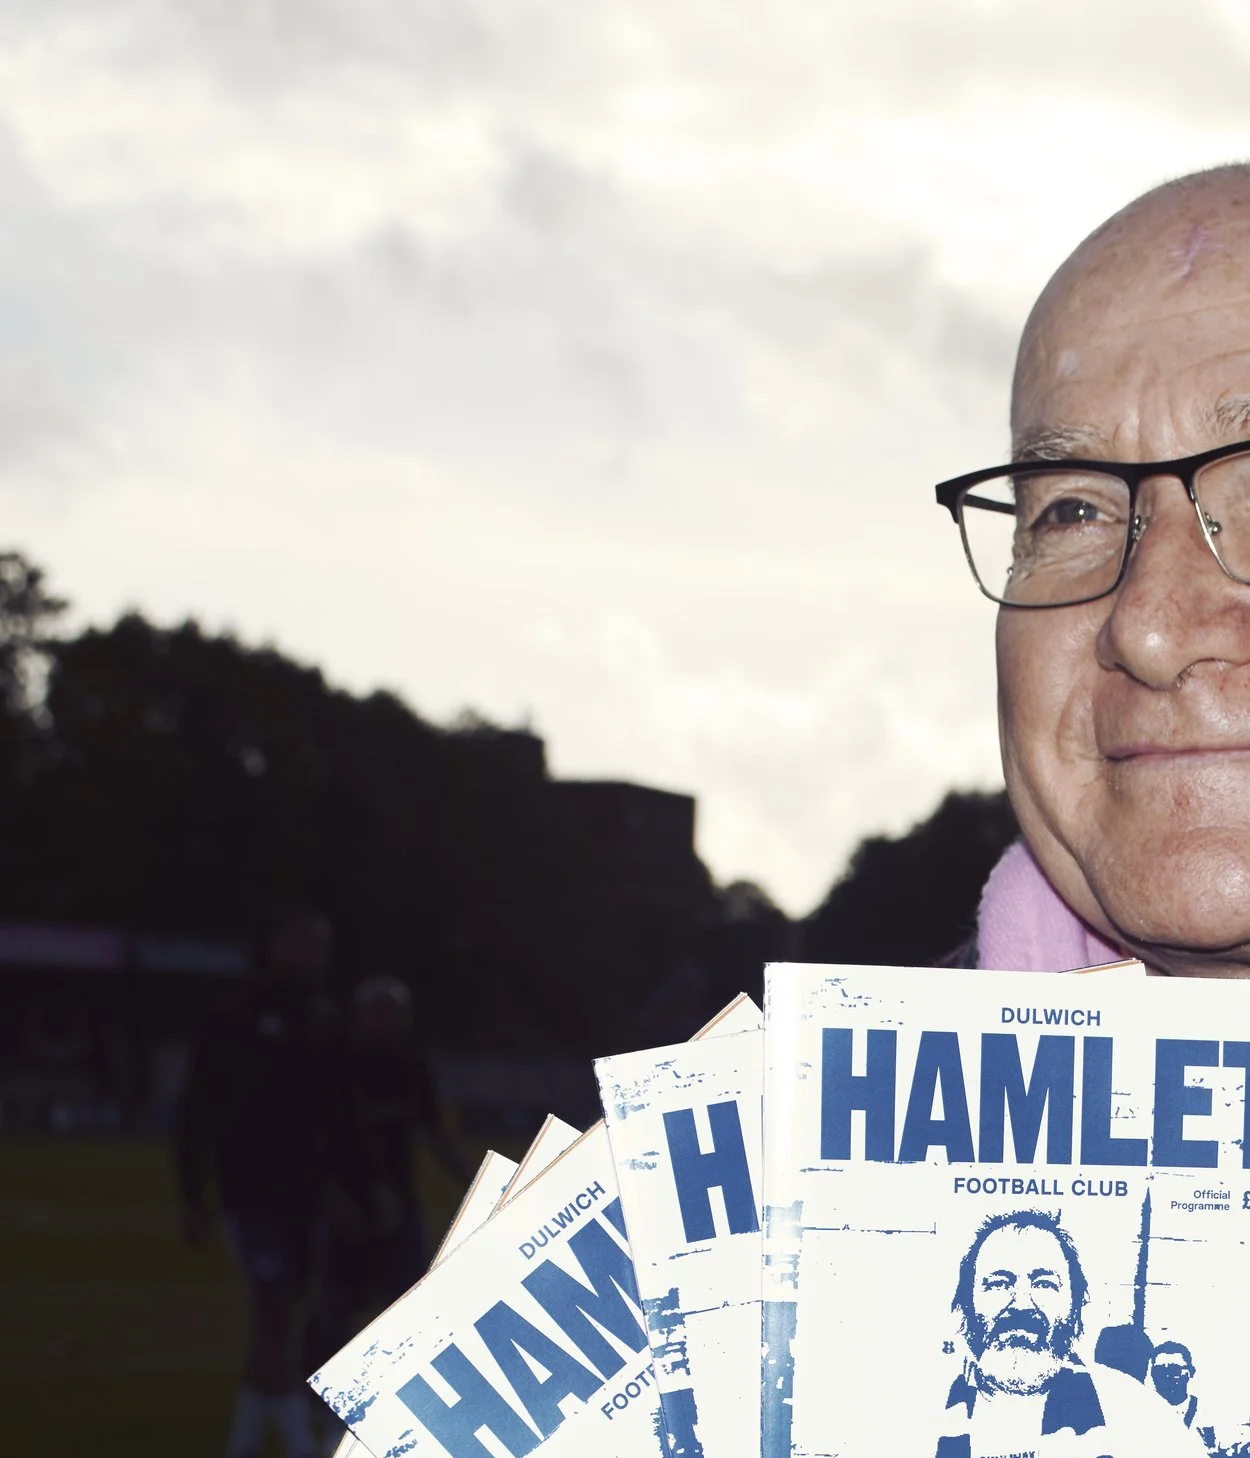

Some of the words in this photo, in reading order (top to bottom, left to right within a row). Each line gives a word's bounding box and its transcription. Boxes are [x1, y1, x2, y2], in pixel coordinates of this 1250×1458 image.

[1001, 1006, 1101, 1026] DULWICH
[953, 1177, 1064, 1196] FOOTBALL
[1071, 1179, 1129, 1197] CLUB
[1193, 1189, 1231, 1201] Official
[1170, 1201, 1231, 1213] Programme
[518, 1180, 607, 1260] DULWICH
[600, 1362, 656, 1420] FOOT
